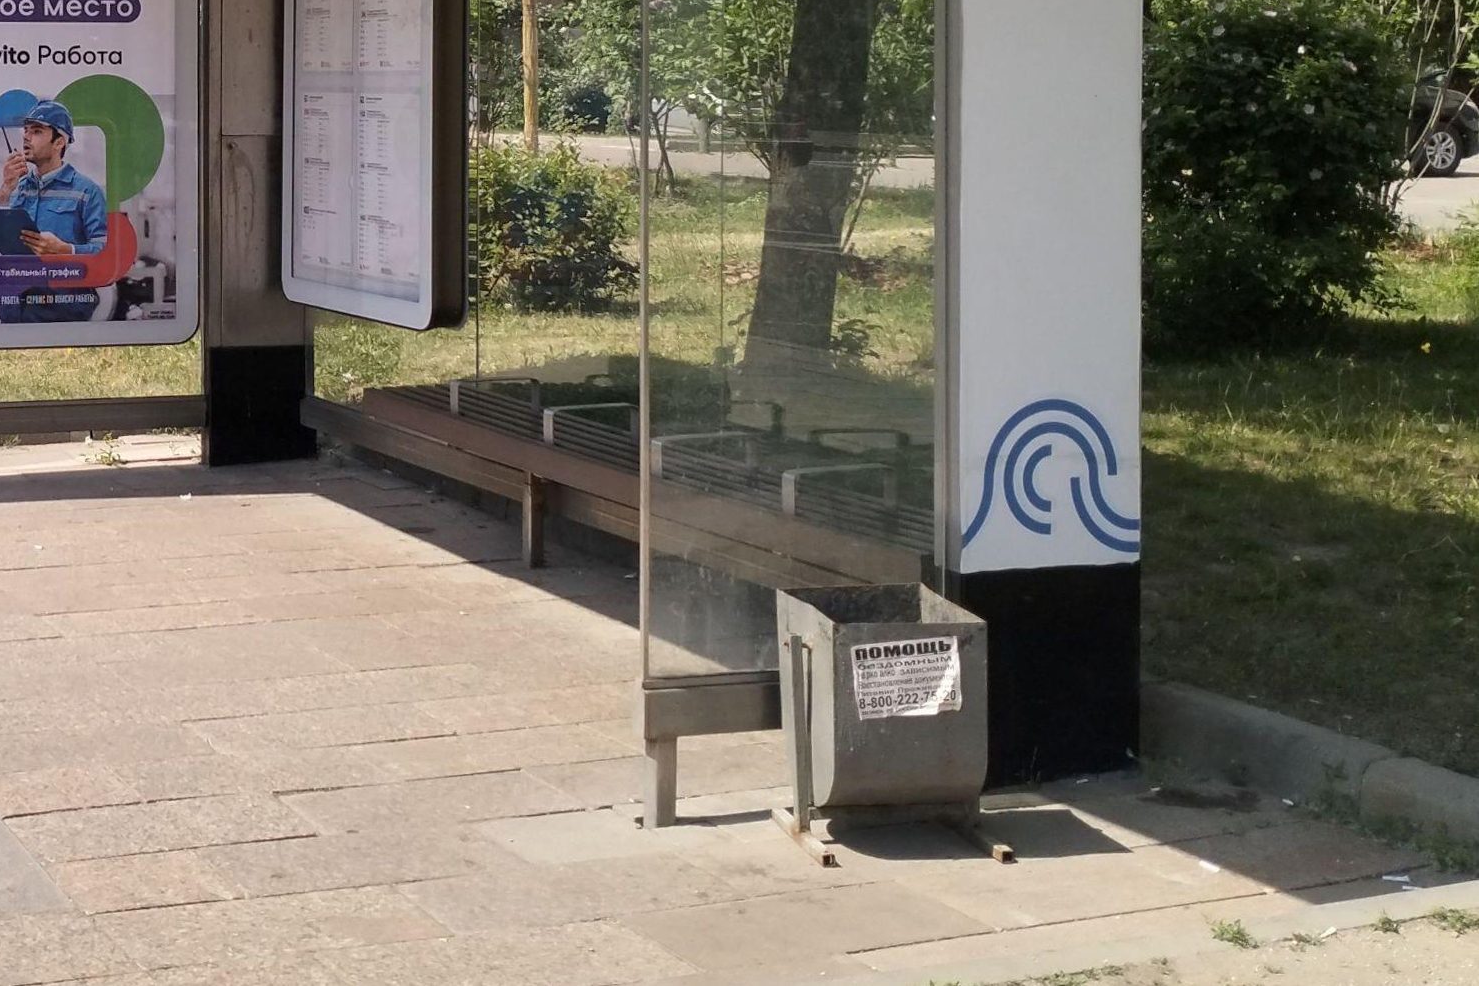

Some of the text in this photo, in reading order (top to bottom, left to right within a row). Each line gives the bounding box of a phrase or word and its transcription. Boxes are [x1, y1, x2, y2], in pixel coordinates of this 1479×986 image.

[38, 44, 123, 65] Работа
[48, 266, 80, 279] график
[855, 640, 952, 660] ПОМОЩЬ
[857, 655, 952, 670] бездомным
[859, 689, 956, 709] 8-800-222-7520
